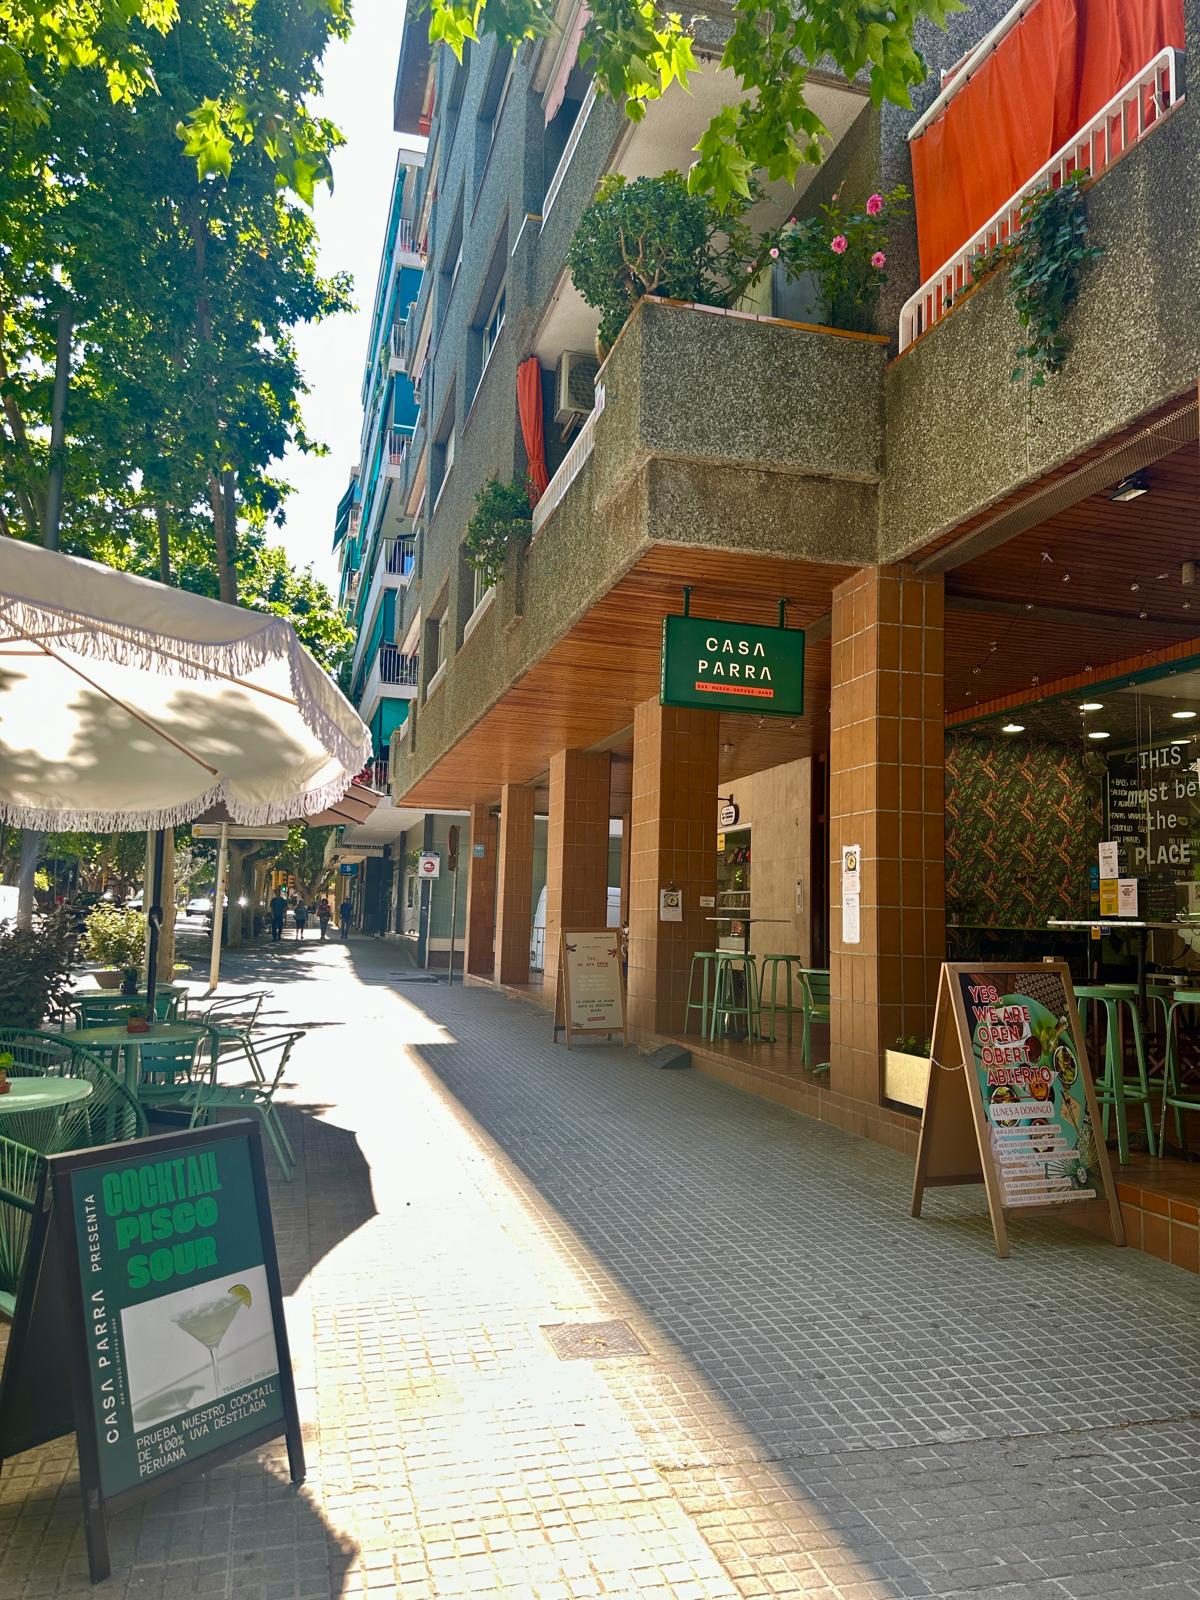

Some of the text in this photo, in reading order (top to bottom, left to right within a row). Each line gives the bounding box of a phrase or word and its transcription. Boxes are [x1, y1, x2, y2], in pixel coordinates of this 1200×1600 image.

[706, 637, 765, 657] CASA
[698, 659, 772, 681] PARRA
[1138, 746, 1181, 770] THIS
[1127, 779, 1197, 804] must be
[1148, 810, 1177, 830] the
[1135, 842, 1191, 866] PLACE
[968, 985, 1003, 1004] YES,
[972, 1005, 1031, 1024] WE ARE
[978, 1026, 1020, 1043] OPEN
[981, 1046, 1031, 1065] OBERT
[987, 1066, 1051, 1086] ABIERTO
[992, 1105, 1052, 1117] LUNES A DOMINGO
[102, 1151, 222, 1217] COCKTAIL
[84, 1194, 102, 1273] PRESENTA
[115, 1196, 218, 1250] PISCO
[127, 1236, 219, 1289] SOUR
[91, 1289, 119, 1444] CASA PARRA
[136, 1383, 276, 1450] PRUEBA NUESTRO COCKTAIL
[138, 1399, 267, 1463] DE 100% UVA DESTILADA
[139, 1447, 187, 1477] PERUANA
